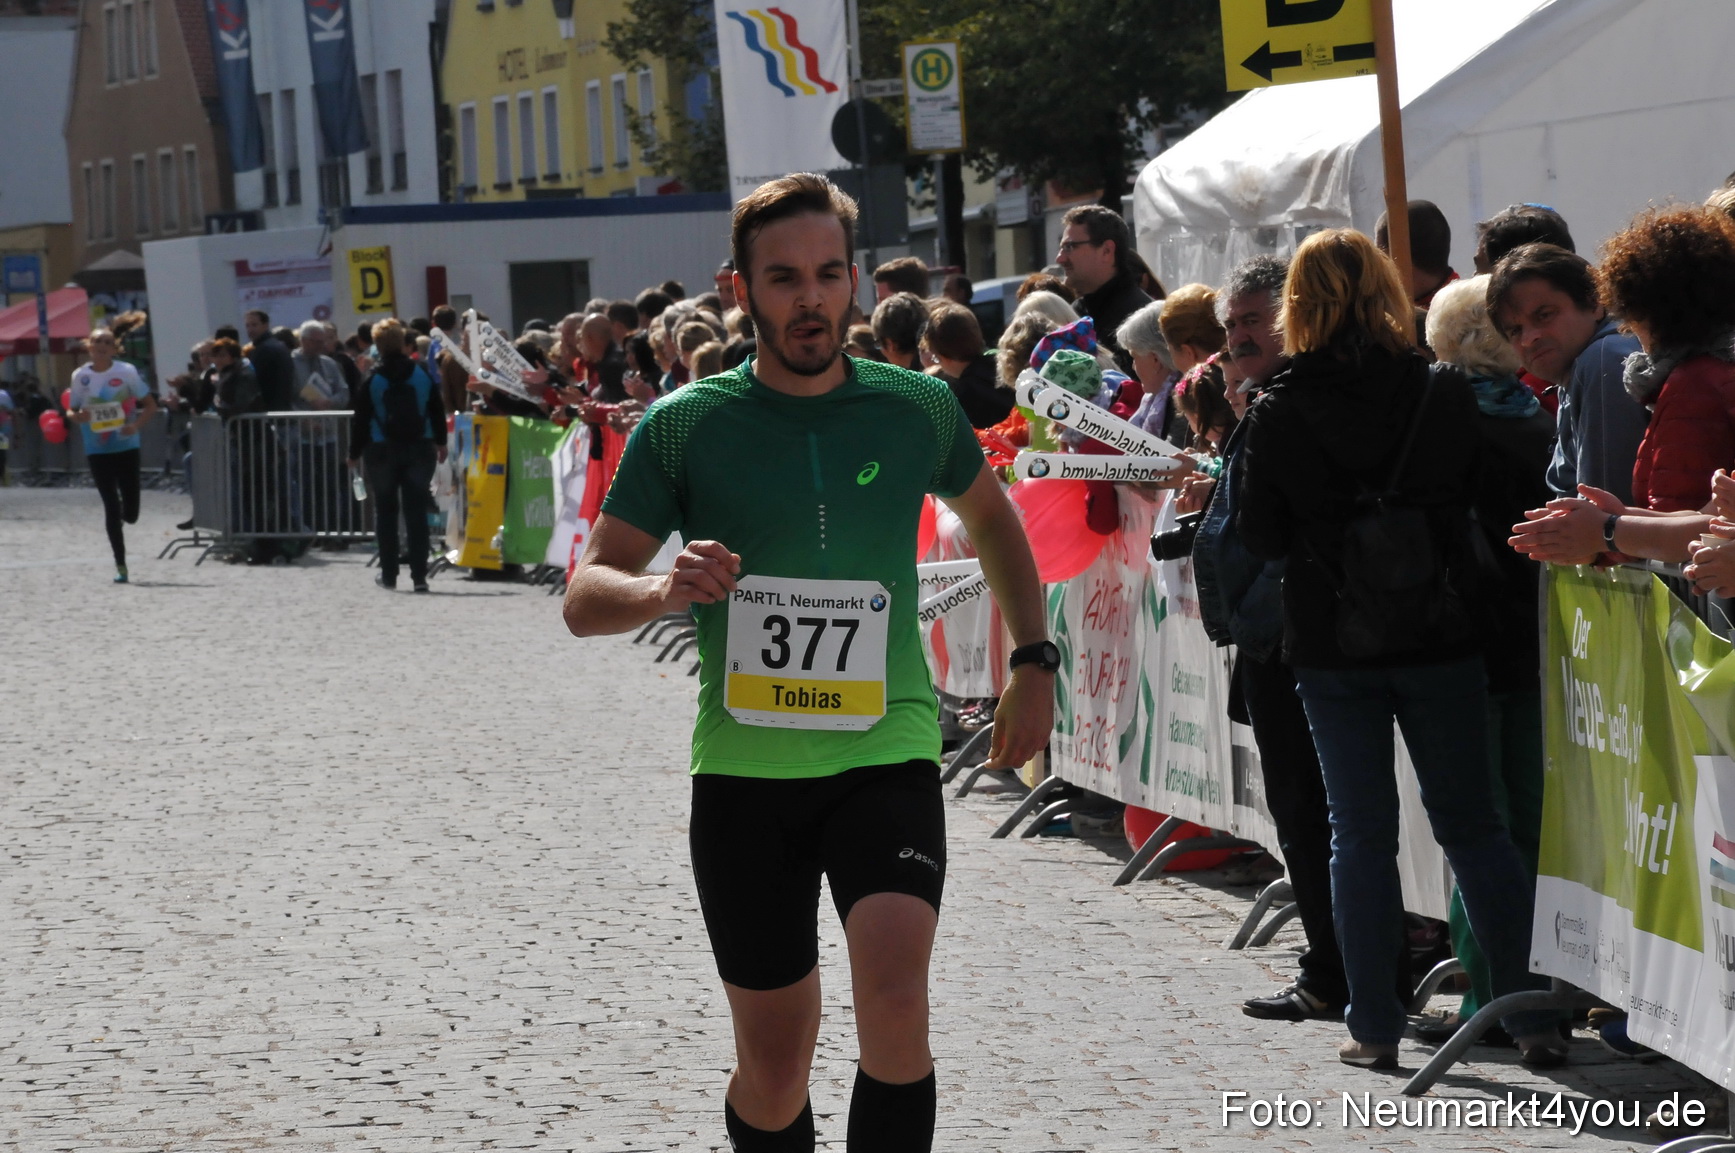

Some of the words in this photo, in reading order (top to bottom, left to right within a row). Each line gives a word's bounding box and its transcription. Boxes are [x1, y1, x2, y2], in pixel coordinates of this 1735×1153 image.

[360, 267, 384, 299] D
[734, 588, 786, 606] PARTL
[790, 593, 865, 609] Neumarkt
[761, 614, 860, 672] 377
[1572, 607, 1592, 659] Der
[732, 661, 739, 672] B
[772, 684, 842, 709] Tobias
[1561, 656, 1606, 752] Neue
[914, 852, 939, 871] asics
